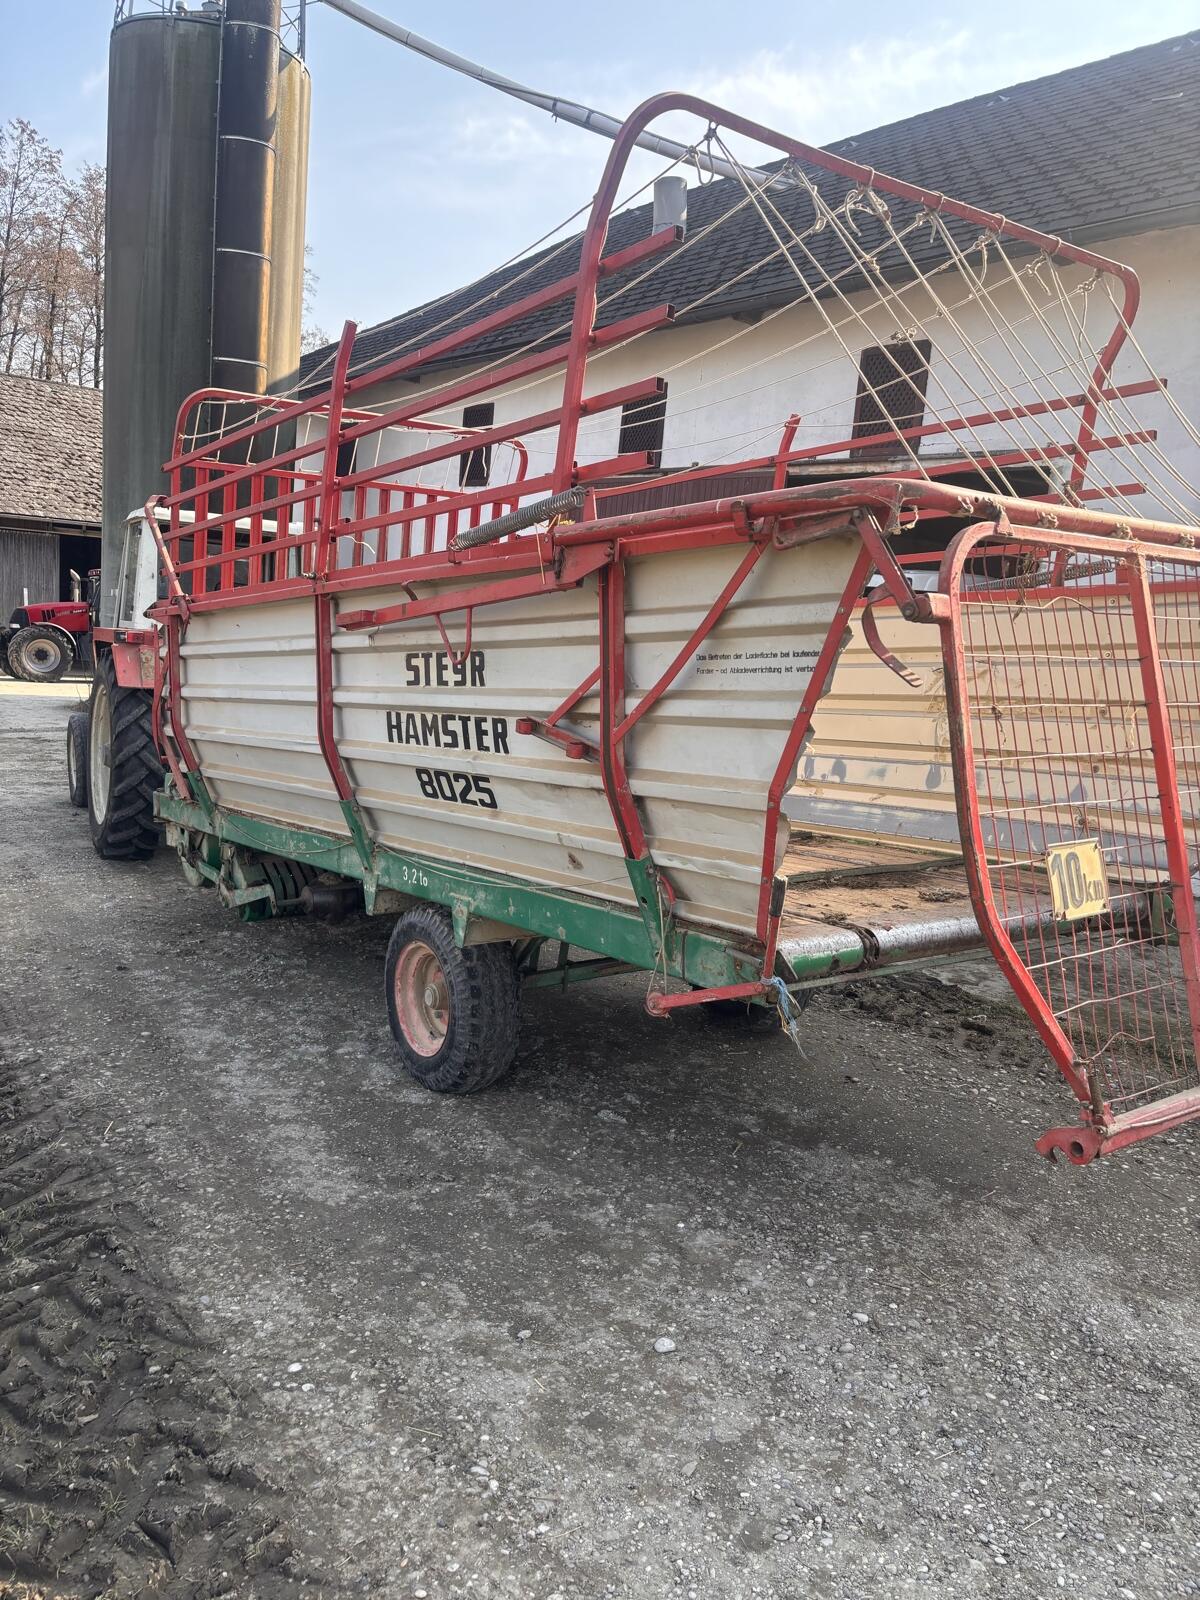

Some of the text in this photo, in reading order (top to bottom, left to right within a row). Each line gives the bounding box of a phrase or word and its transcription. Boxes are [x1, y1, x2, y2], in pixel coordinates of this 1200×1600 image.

[405, 650, 486, 687] STEYR
[708, 652, 731, 661] Betreten
[732, 652, 743, 660] der
[780, 650, 790, 659] bei
[784, 665, 793, 673] ist
[386, 711, 510, 754] HAMSTER
[415, 768, 498, 809] 8025
